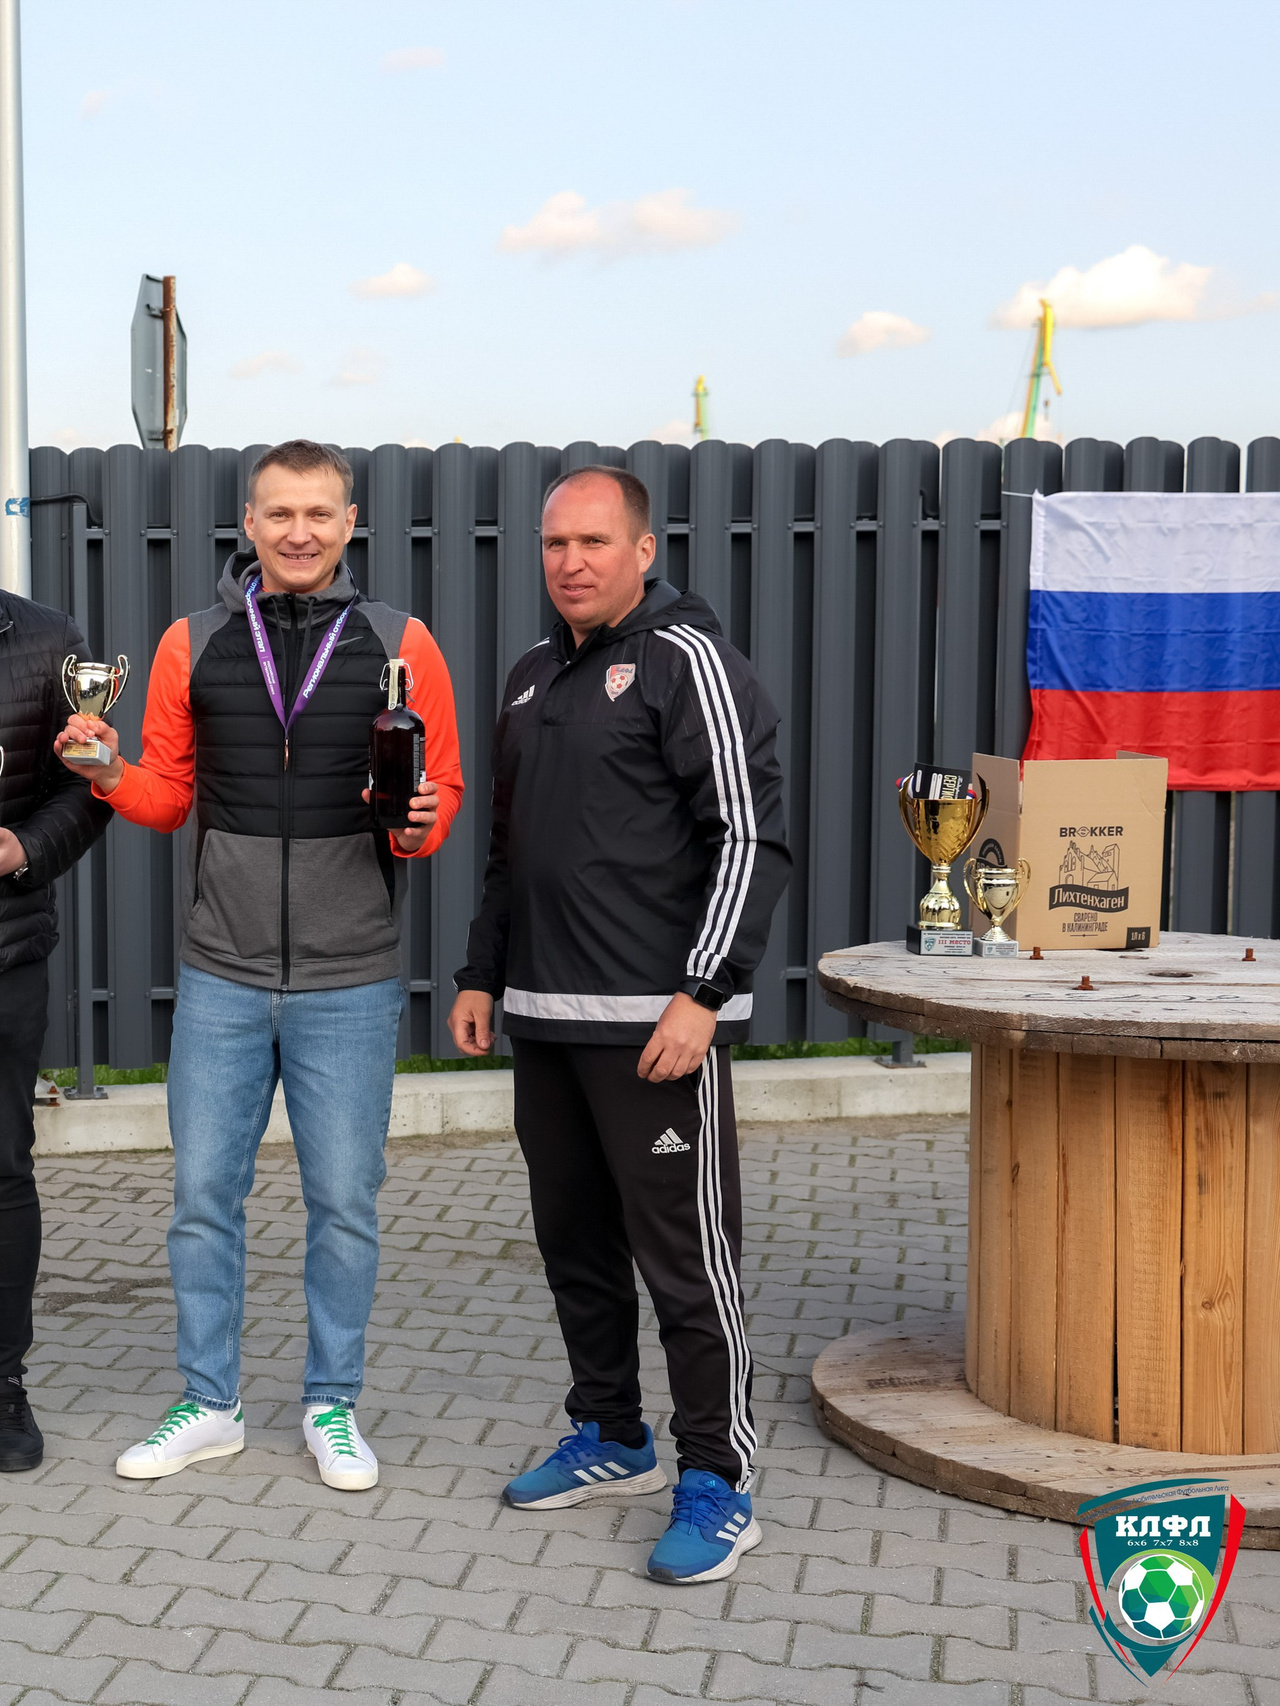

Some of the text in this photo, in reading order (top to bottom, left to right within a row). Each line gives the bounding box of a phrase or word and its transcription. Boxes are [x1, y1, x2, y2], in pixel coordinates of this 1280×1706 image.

[303, 632, 336, 698] Региональный
[1059, 826, 1124, 838] BROKKER
[1052, 888, 1125, 909] Лихтенхаген
[1074, 912, 1098, 922] СВАРЕНО
[1062, 922, 1108, 932] В КАЛИНИНГРАДЕ
[651, 1143, 691, 1154] adidas
